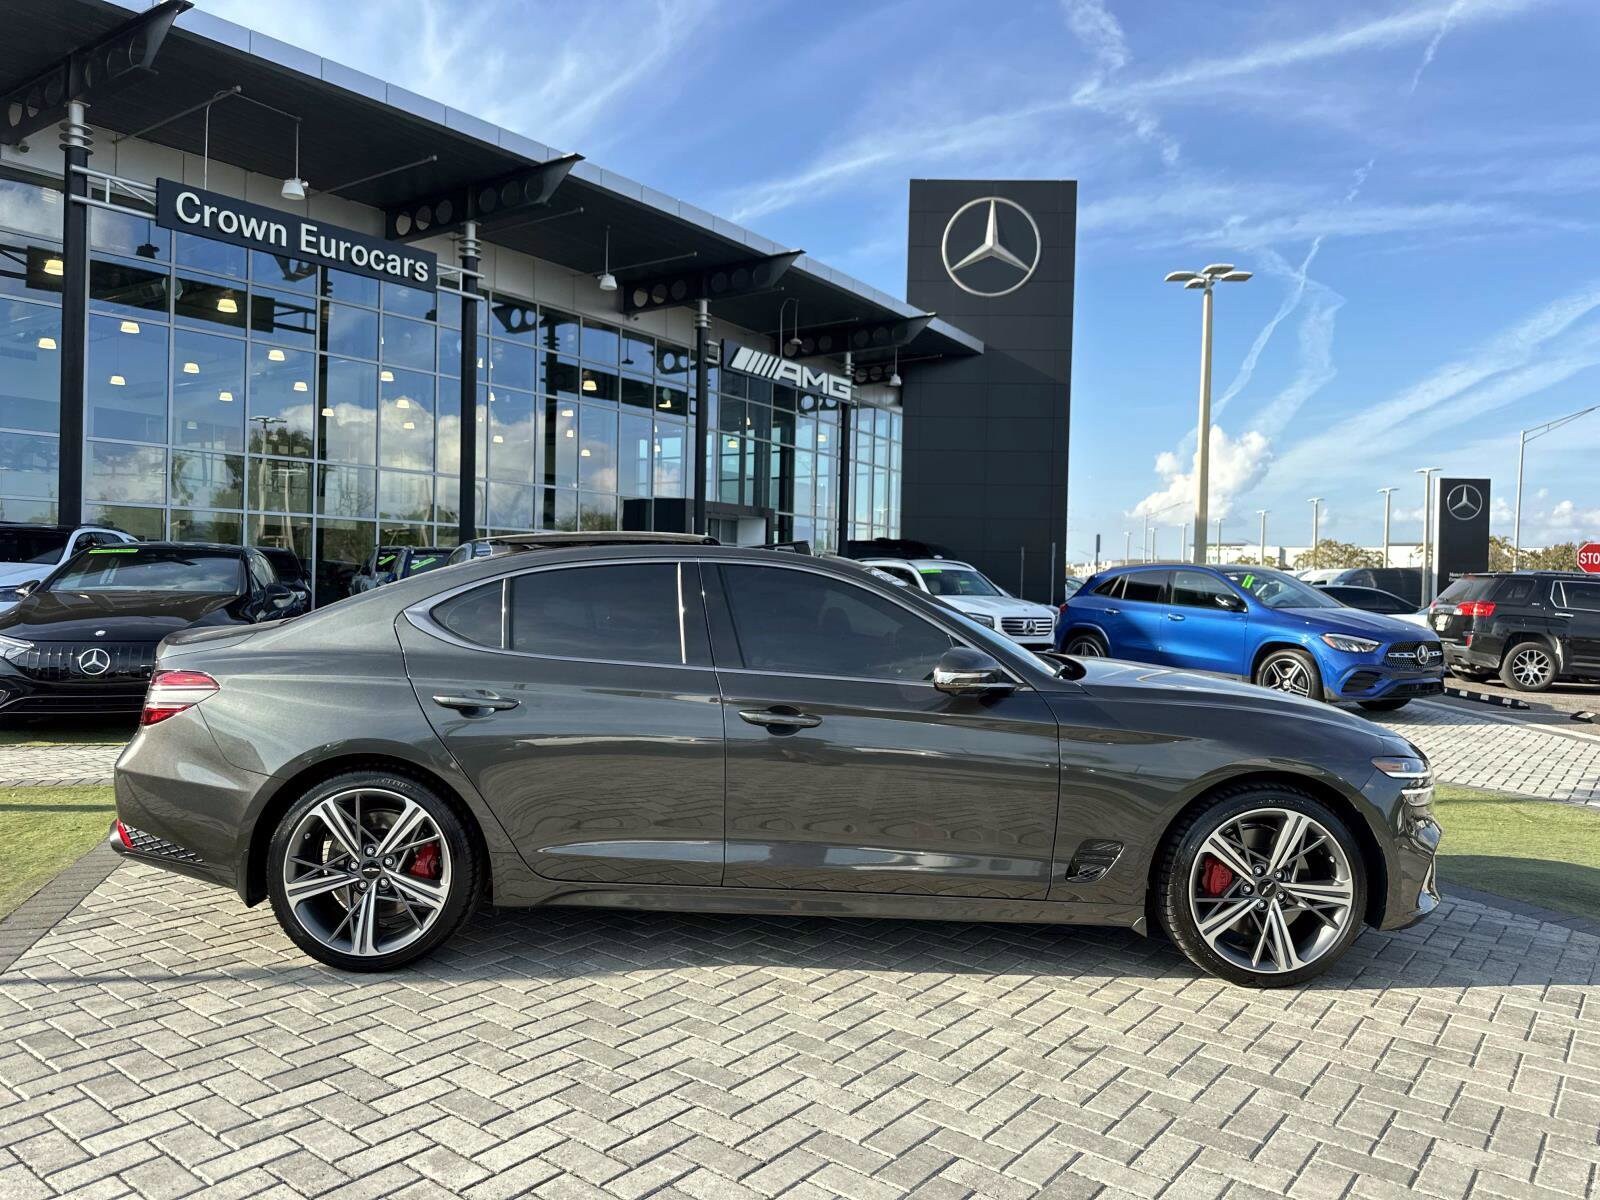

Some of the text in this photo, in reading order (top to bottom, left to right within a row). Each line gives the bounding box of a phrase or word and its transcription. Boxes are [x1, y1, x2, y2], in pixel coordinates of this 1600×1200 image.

[175, 191, 429, 282] Crown Eurocars
[772, 359, 852, 401] AMG
[1580, 552, 1600, 565] STO
